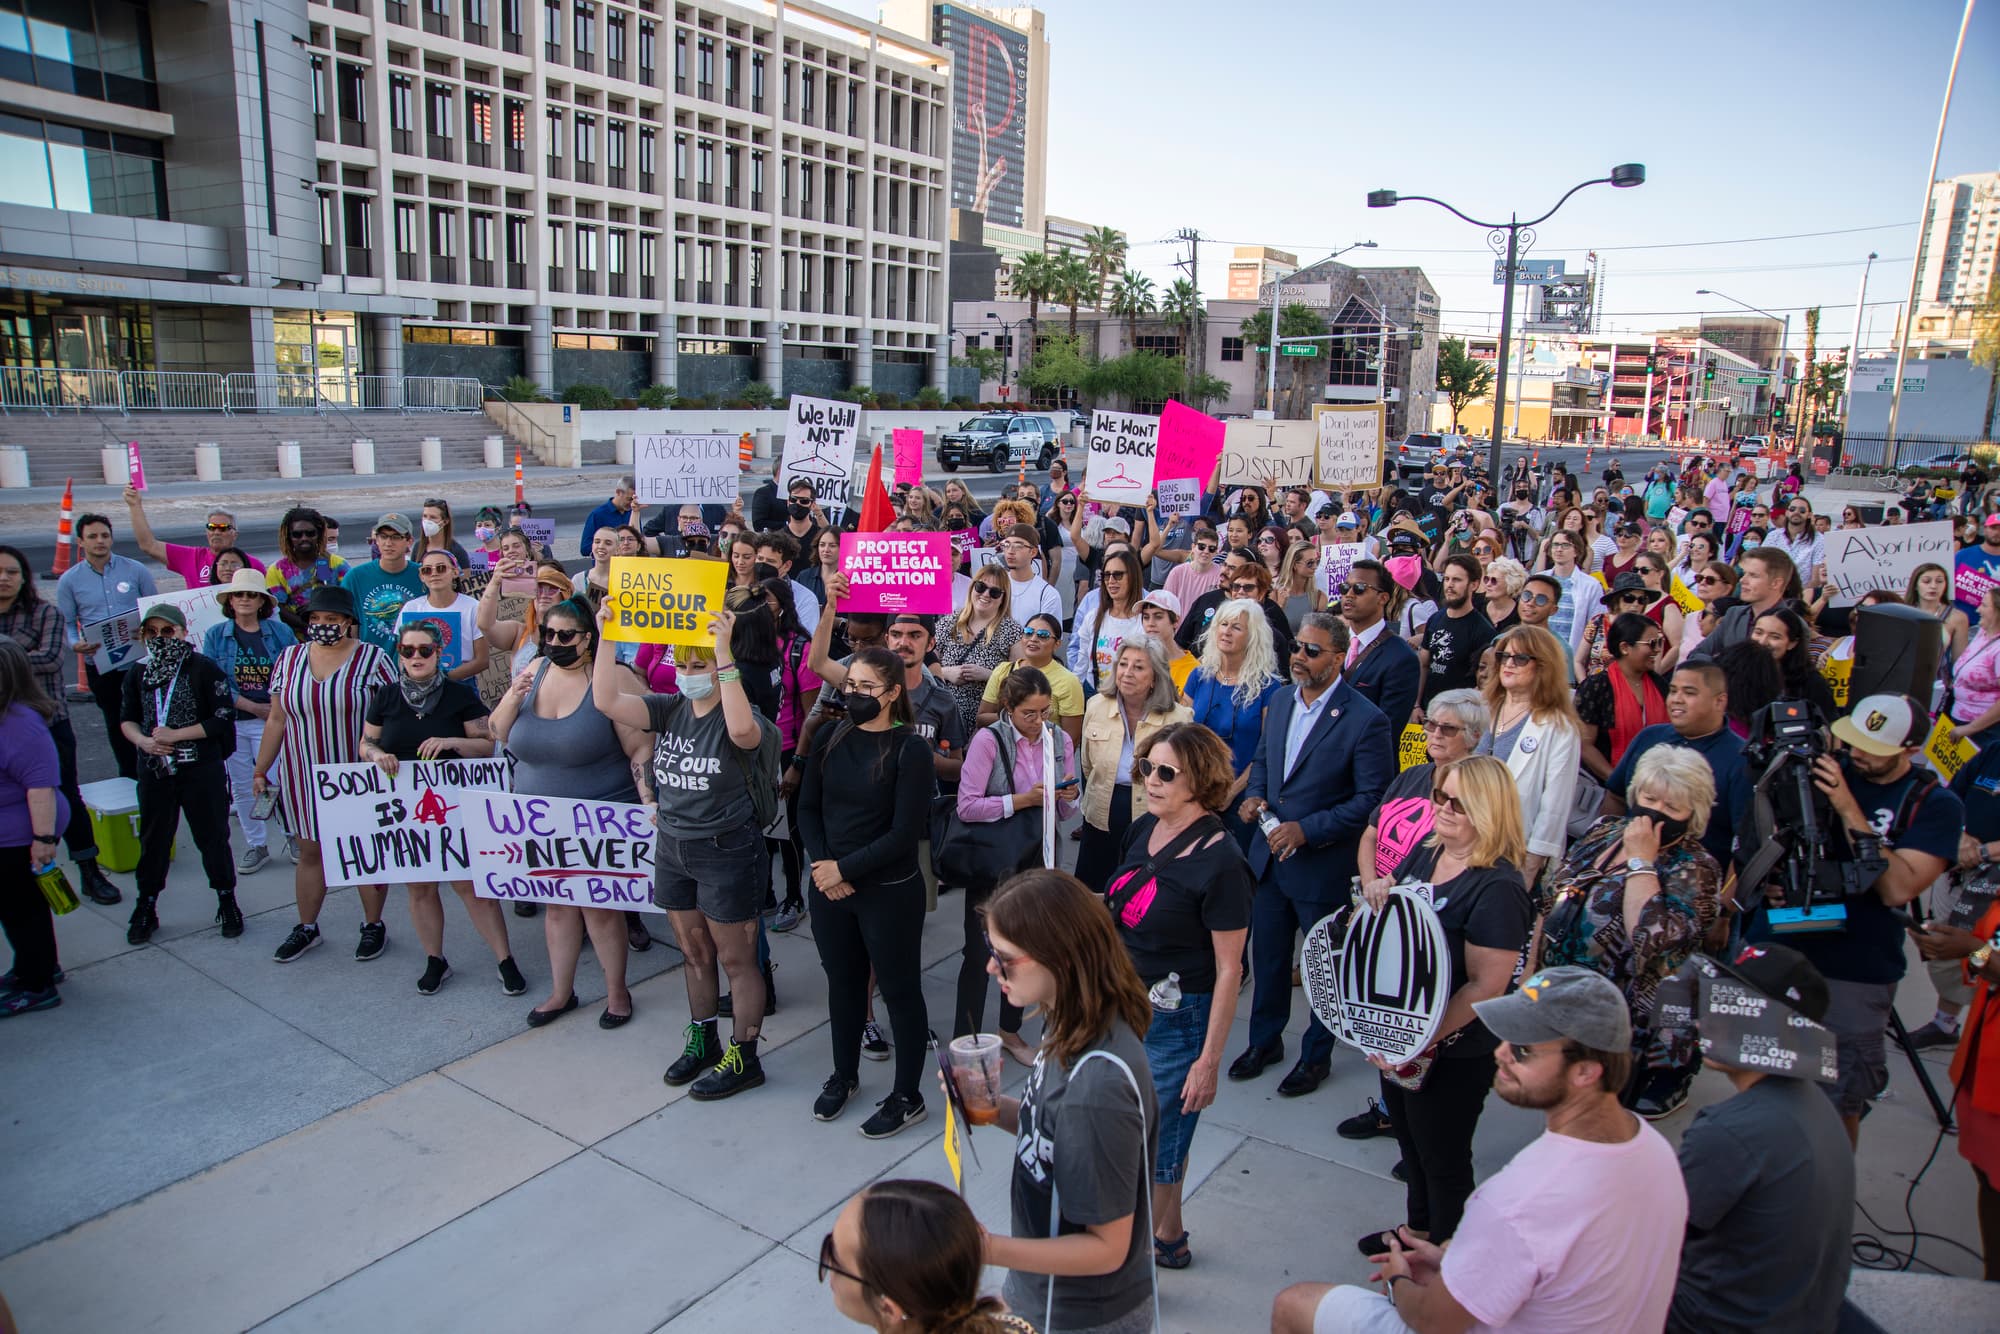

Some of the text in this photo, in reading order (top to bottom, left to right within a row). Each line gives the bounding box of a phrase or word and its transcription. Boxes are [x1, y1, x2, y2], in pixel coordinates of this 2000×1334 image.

[967, 24, 1016, 138] D
[1016, 43, 1026, 148] LAS VEGAS
[1288, 347, 1311, 355] Bridger
[798, 403, 824, 425] We
[1353, 416, 1375, 429] want
[807, 427, 844, 446] NOT
[1096, 414, 1157, 438] WE WONT
[1256, 425, 1285, 448] I
[644, 438, 731, 460] ABORTION
[1009, 448, 1031, 457] POLICE
[1090, 436, 1156, 458] GO BACK
[1328, 450, 1344, 461] Get
[678, 462, 696, 474] is
[1225, 452, 1313, 481] DISSENT
[640, 475, 738, 499] HEALTHCARE
[816, 477, 850, 504] BACK
[1159, 484, 1178, 494] BANS
[1160, 494, 1195, 504] OFF OUR
[1161, 503, 1190, 513] BODIES
[857, 540, 928, 555] PROTECT
[1841, 535, 1950, 564] Abortion
[845, 556, 942, 572] SAFE, LEGAL
[1876, 559, 1892, 567] is
[620, 572, 673, 592] BANS
[850, 572, 936, 586] ABORTION
[363, 587, 381, 610] PROTECT
[619, 591, 707, 612] OFF OUR
[620, 610, 697, 630] BODIES
[102, 622, 116, 651] NEVADA
[247, 647, 254, 655] A
[243, 666, 270, 675] READ
[661, 731, 696, 754] ANS
[413, 760, 506, 791] AUTONOMY
[680, 756, 722, 774] OUR
[654, 768, 710, 791] ODIES
[375, 798, 407, 828] IS
[485, 798, 654, 839] WE ARE
[337, 828, 431, 880] HUMAN
[525, 837, 655, 869] NEVER
[486, 871, 576, 902] GOING
[1343, 893, 1438, 1016] NOW
[1306, 949, 1321, 1009] FOR WOMEN
[1309, 936, 1330, 1021] ORGANIZATION
[1317, 928, 1340, 1031] NATIONAL
[1710, 993, 1768, 1009] OFF OUR
[1712, 983, 1745, 997] BANS
[1348, 1006, 1424, 1031] NATIONAL
[1710, 1003, 1761, 1018] BODIES
[1352, 1021, 1416, 1044] ORGANIZATION
[1743, 1033, 1778, 1048] BANS
[1360, 1035, 1407, 1053] FOR WOMEN
[1741, 1043, 1798, 1061] OFF OUR
[1739, 1053, 1793, 1070] BODIES
